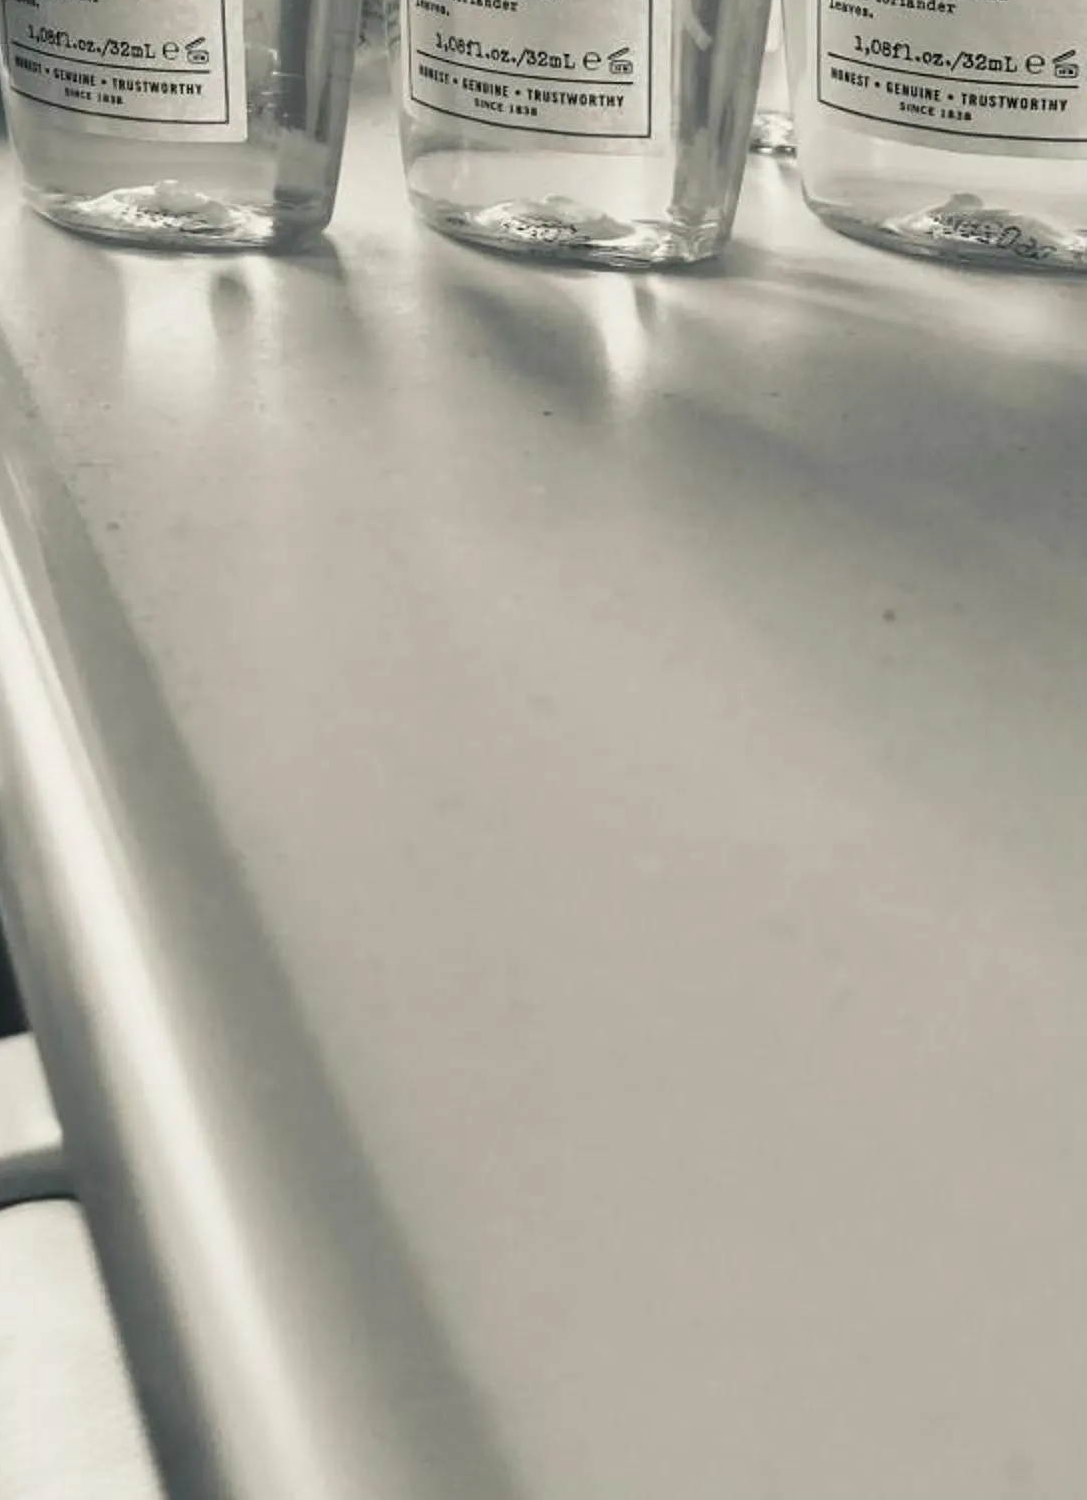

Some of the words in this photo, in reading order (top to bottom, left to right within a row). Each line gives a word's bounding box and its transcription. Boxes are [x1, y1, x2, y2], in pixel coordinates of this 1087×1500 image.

[113, 79, 202, 95] TRUSTWORTHY
[527, 89, 625, 108] TRUSTWORTHY
[961, 93, 1068, 111] TRUSTWORTHY
